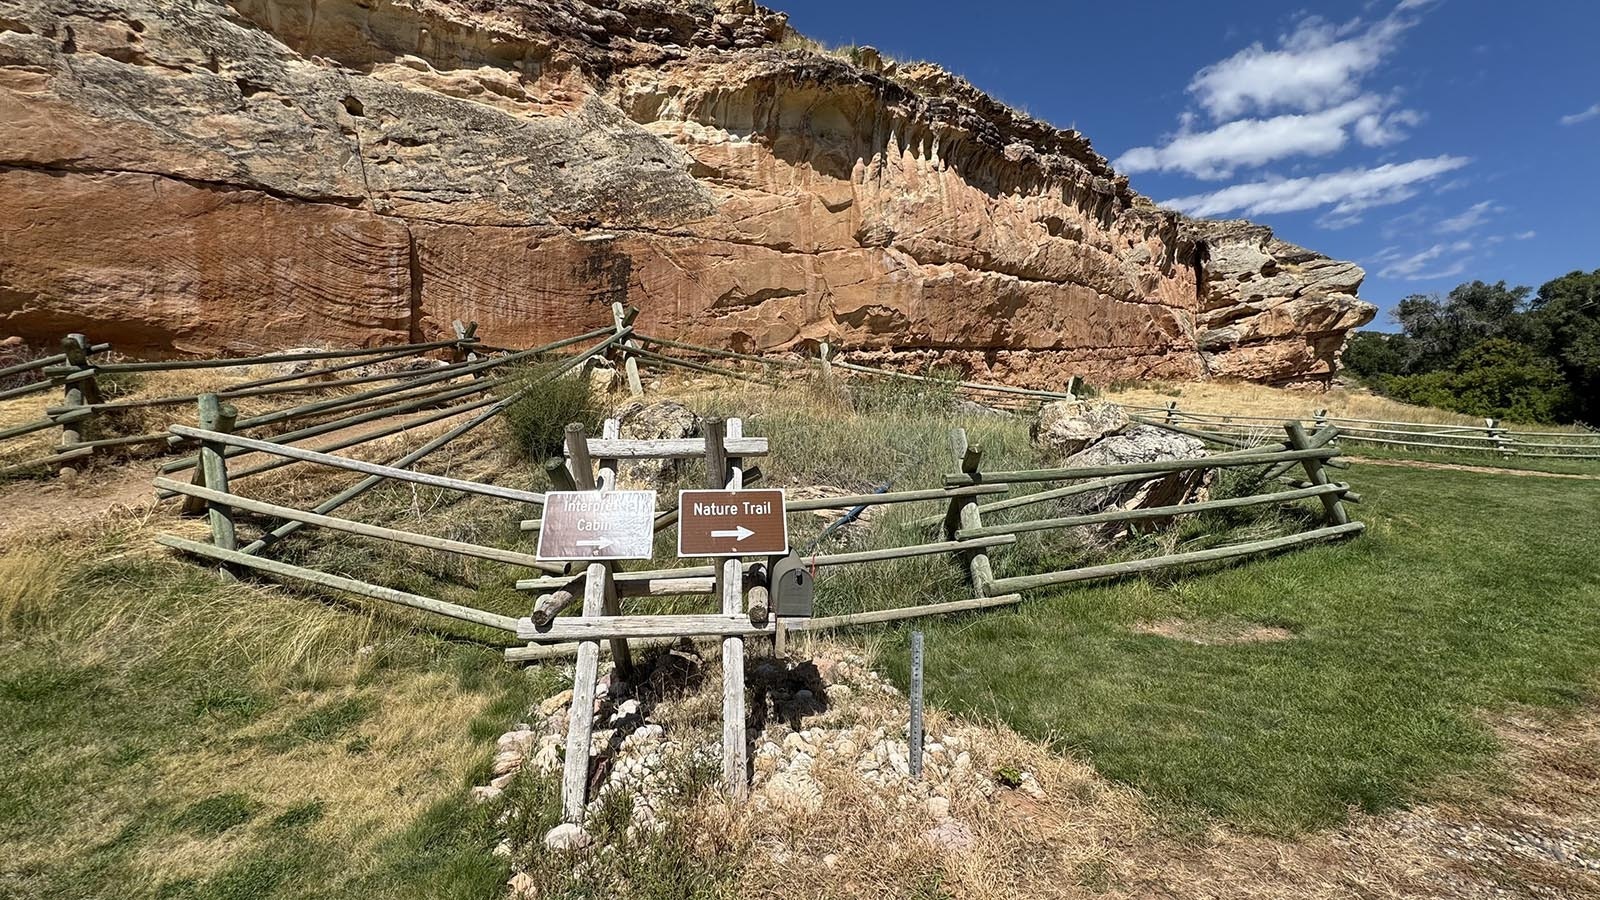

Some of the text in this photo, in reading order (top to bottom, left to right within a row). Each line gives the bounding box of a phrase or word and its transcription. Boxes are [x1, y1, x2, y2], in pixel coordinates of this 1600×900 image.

[564, 500, 636, 515] Interprete
[693, 501, 771, 516] Nature Trail
[577, 518, 612, 532] Cabin
